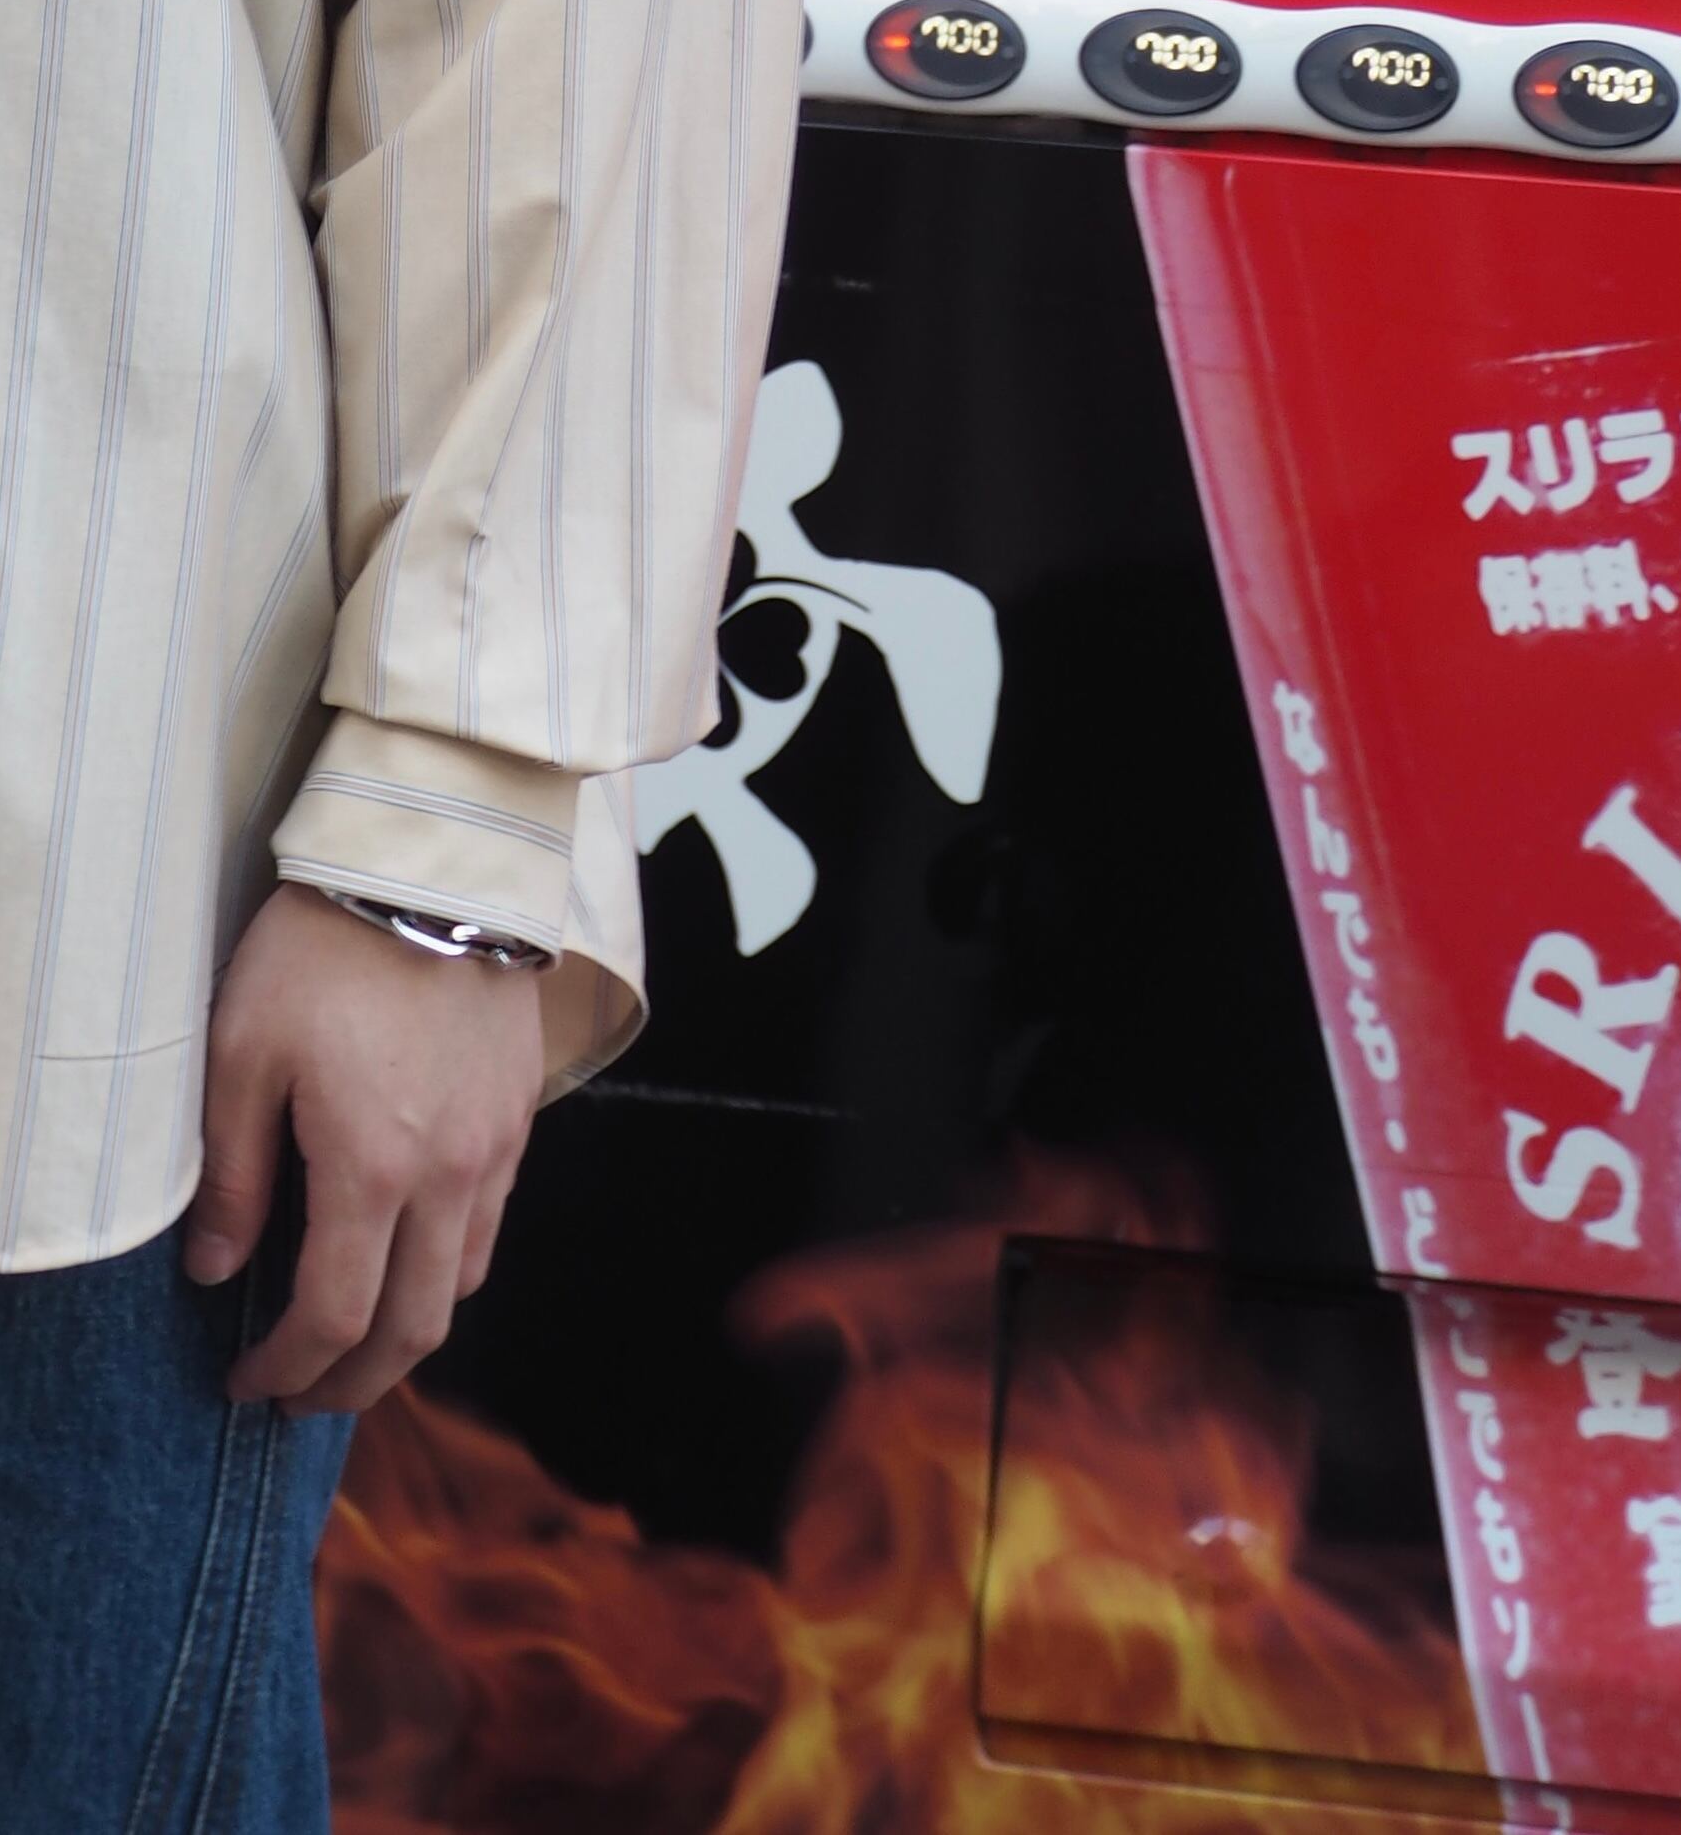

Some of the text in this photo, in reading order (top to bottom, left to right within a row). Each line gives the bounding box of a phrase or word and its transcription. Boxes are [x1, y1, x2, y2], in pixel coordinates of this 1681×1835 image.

[920, 14, 999, 56] 700
[1135, 32, 1218, 73] 700
[1351, 46, 1432, 88] 700
[1571, 64, 1654, 105] 700
